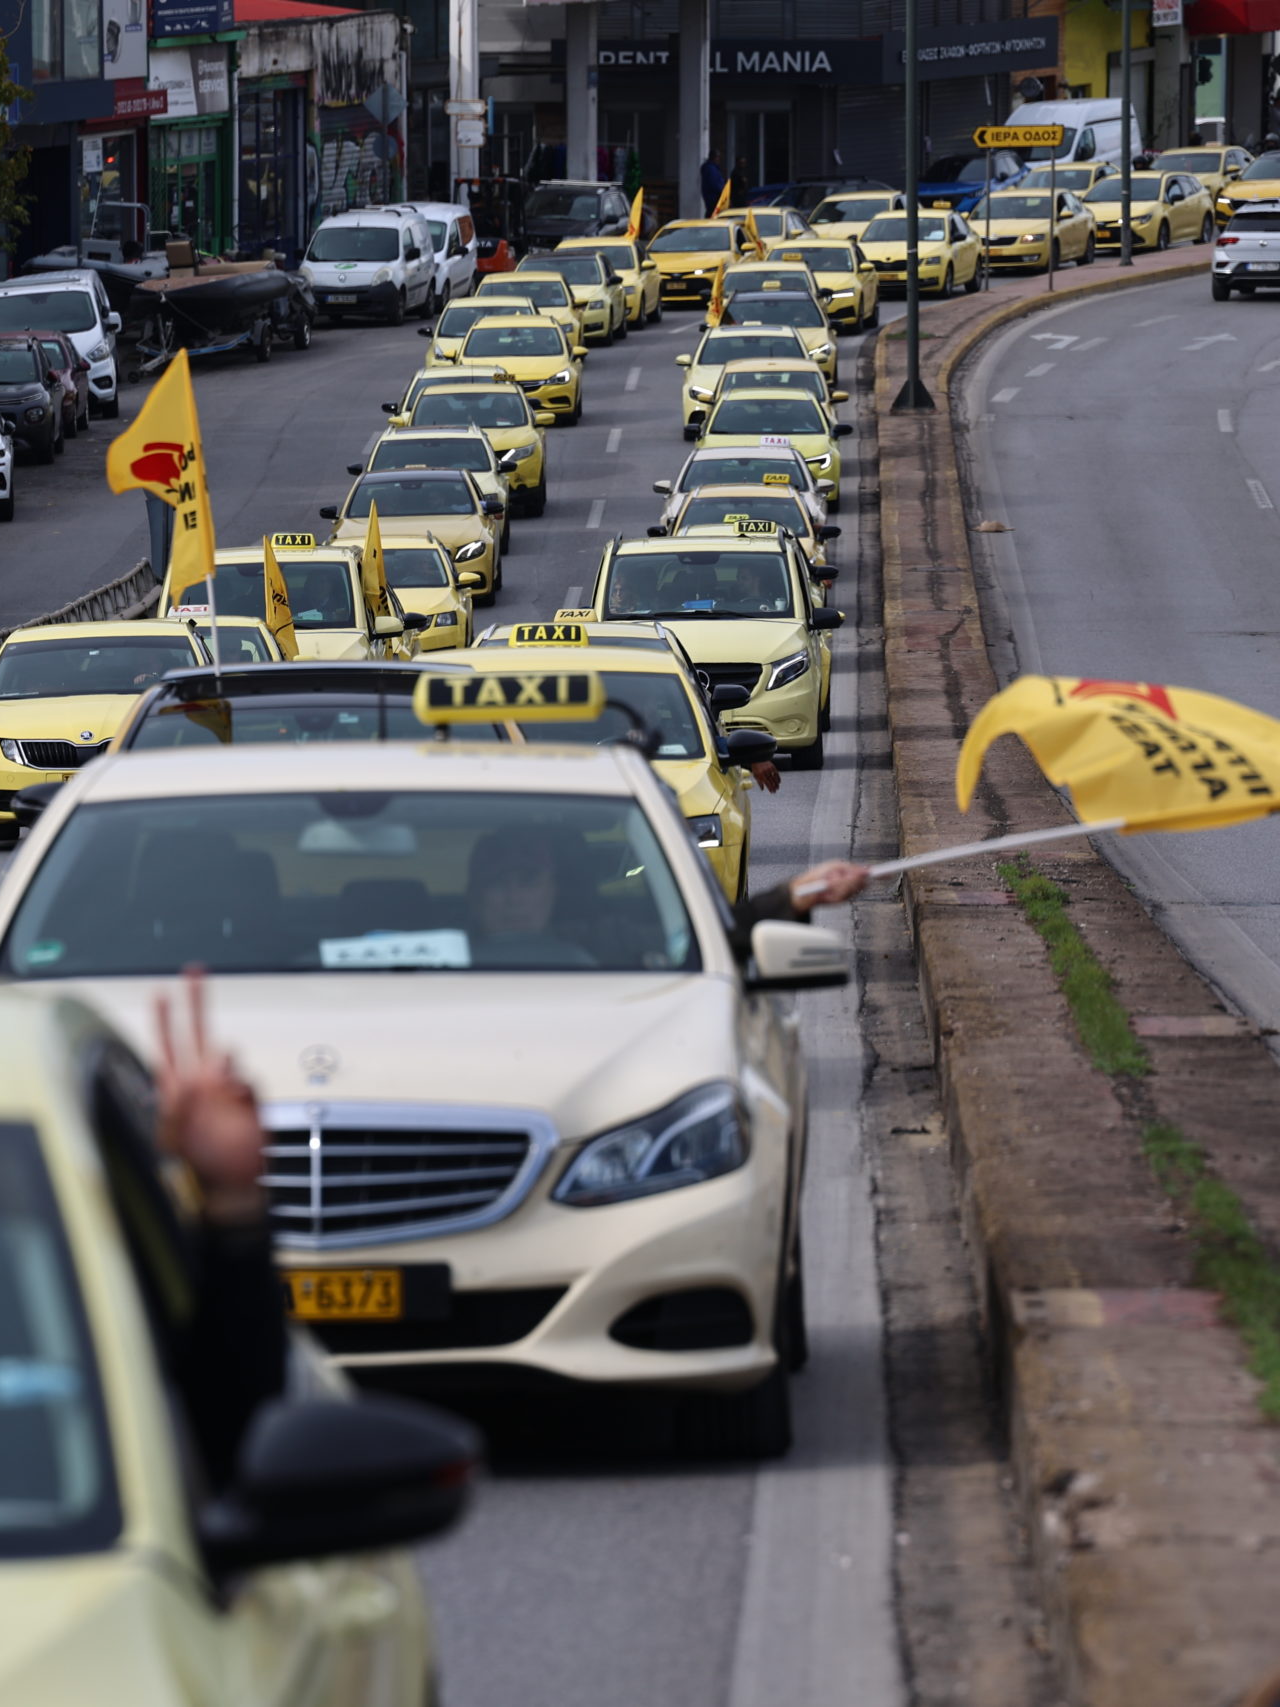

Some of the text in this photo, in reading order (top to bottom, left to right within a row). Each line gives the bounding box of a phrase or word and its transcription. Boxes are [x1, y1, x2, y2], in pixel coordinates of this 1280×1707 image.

[737, 51, 832, 72] MANIA
[991, 130, 1058, 141] ΙΕΡΑ ΟΔΟΣ
[741, 522, 769, 532] TAXI
[278, 535, 309, 545] TAXI
[559, 610, 591, 618] TAXI
[521, 626, 576, 640] TAXI
[444, 676, 569, 706] TAXI
